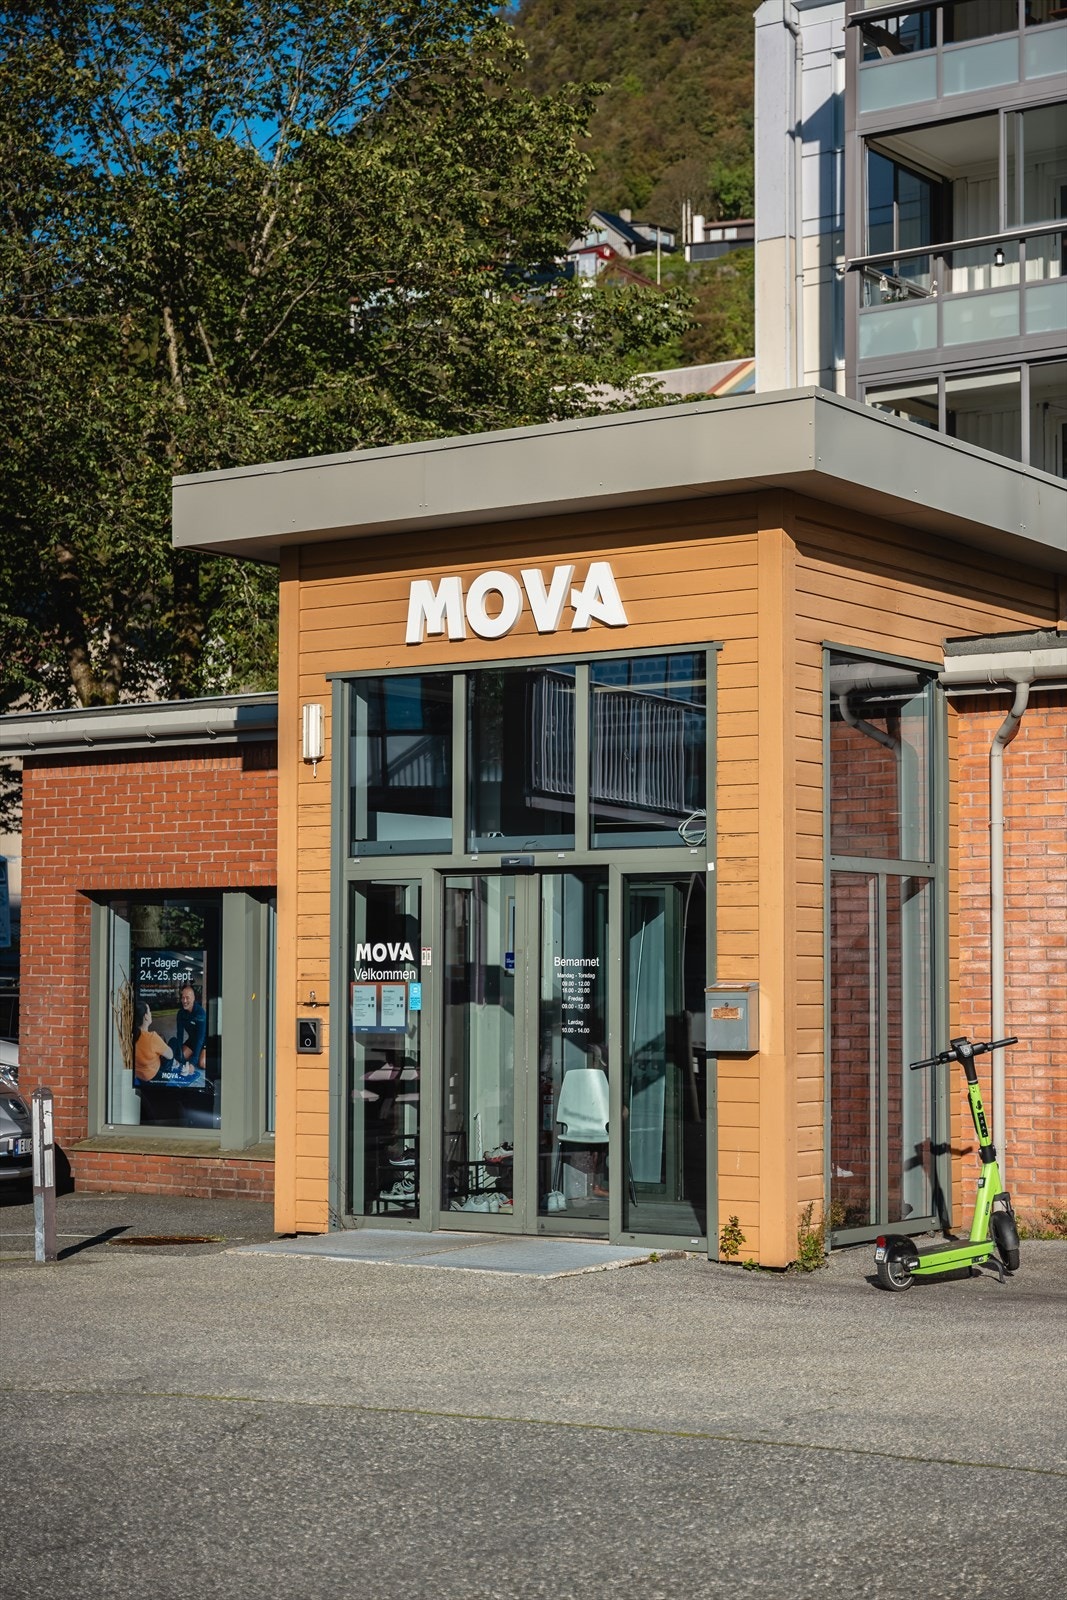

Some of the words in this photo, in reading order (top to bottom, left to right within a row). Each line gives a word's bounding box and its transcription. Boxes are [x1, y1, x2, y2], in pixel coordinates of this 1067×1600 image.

[405, 561, 629, 645] MOVA
[355, 942, 414, 962] MOVA
[140, 957, 180, 970] PT-dager
[554, 956, 599, 966] Bemannet
[140, 970, 170, 980] 24.-25.
[172, 972, 194, 982] sept.
[354, 968, 416, 980] Velkommen
